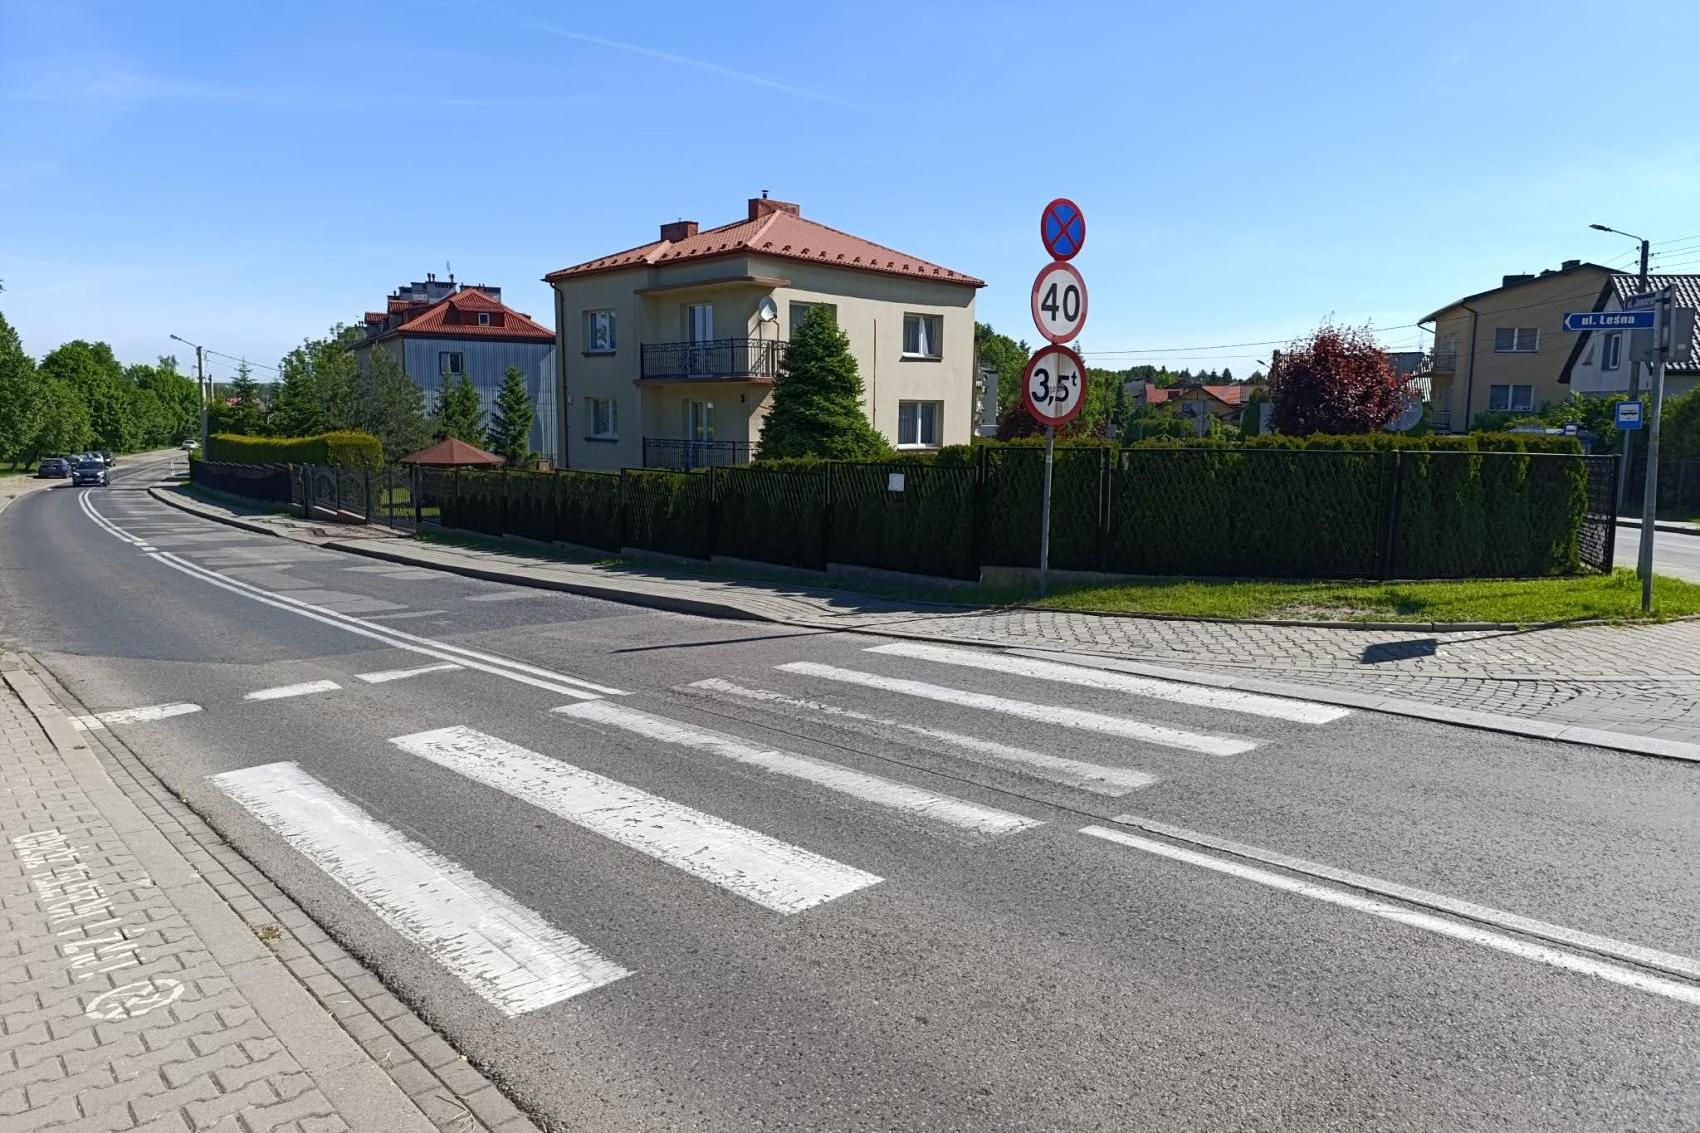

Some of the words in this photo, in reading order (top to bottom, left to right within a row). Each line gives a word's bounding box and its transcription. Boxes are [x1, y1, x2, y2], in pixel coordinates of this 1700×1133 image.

[1041, 283, 1080, 322] 40
[1582, 315, 1597, 325] ul.
[1600, 314, 1635, 325] Leśna
